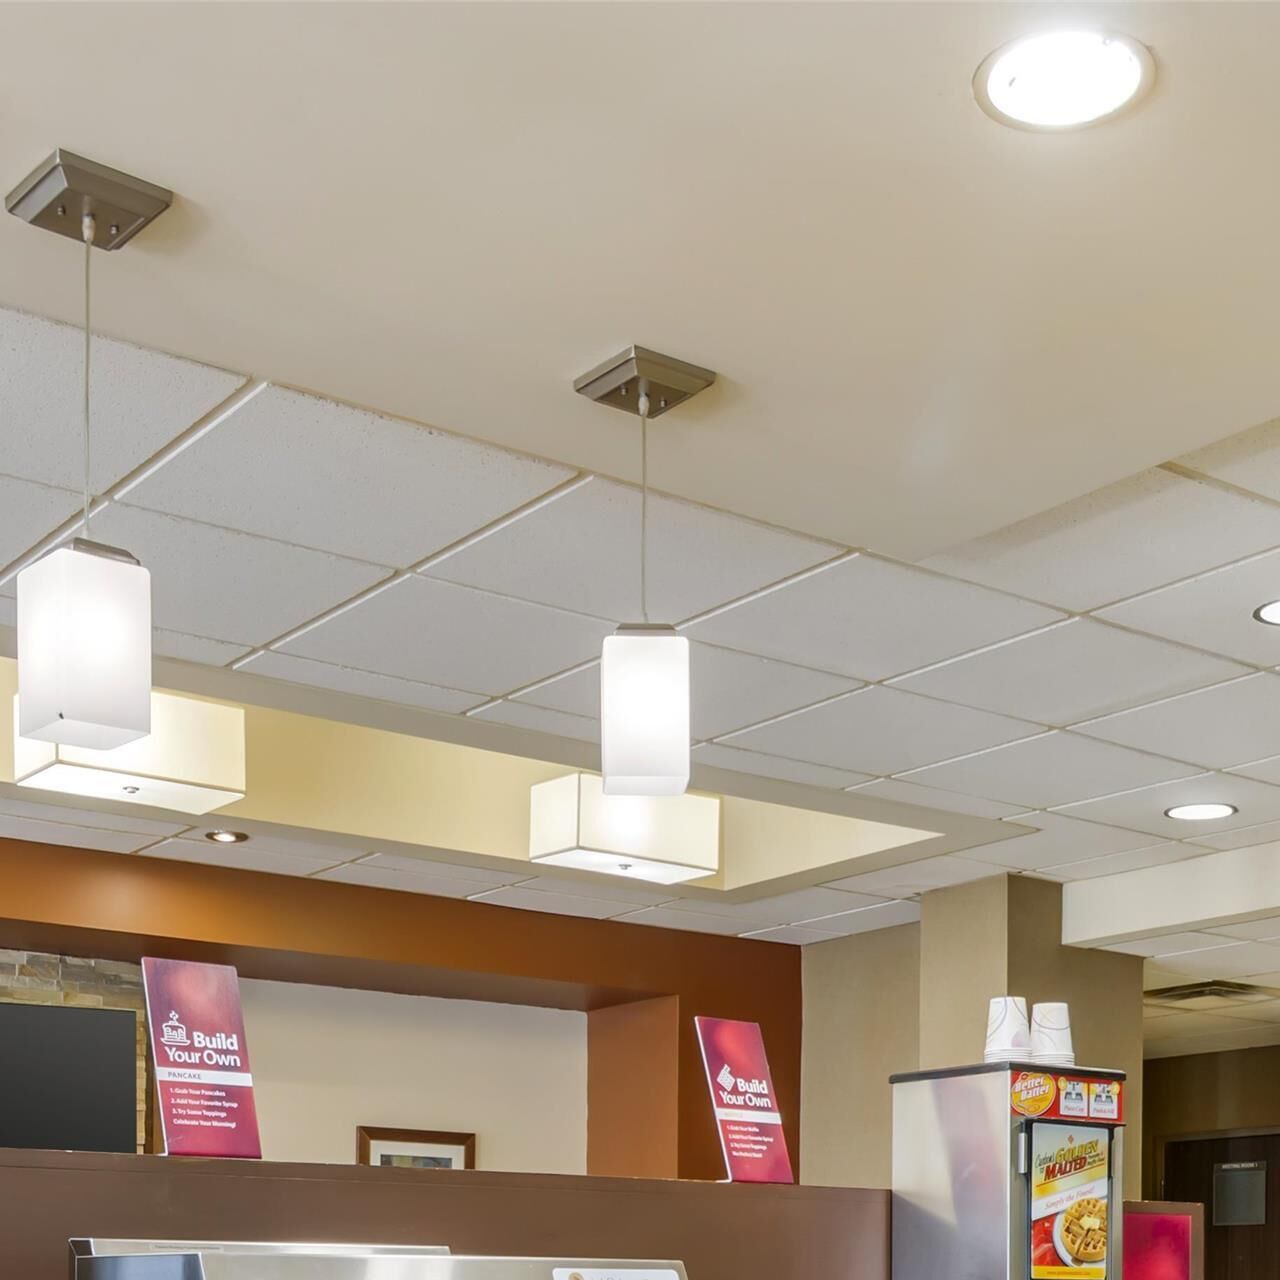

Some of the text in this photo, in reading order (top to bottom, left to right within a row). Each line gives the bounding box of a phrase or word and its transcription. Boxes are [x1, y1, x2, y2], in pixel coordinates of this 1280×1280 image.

[193, 1031, 239, 1051] Build
[164, 1046, 241, 1067] Your Own
[167, 1071, 202, 1080] PANCAKE
[1014, 1076, 1045, 1092] Better
[736, 1078, 769, 1094] Build
[1021, 1084, 1050, 1101] Batter
[719, 1090, 772, 1108] Your Own
[1056, 1139, 1099, 1163] GOLDEN
[1044, 1156, 1088, 1181] MALTED
